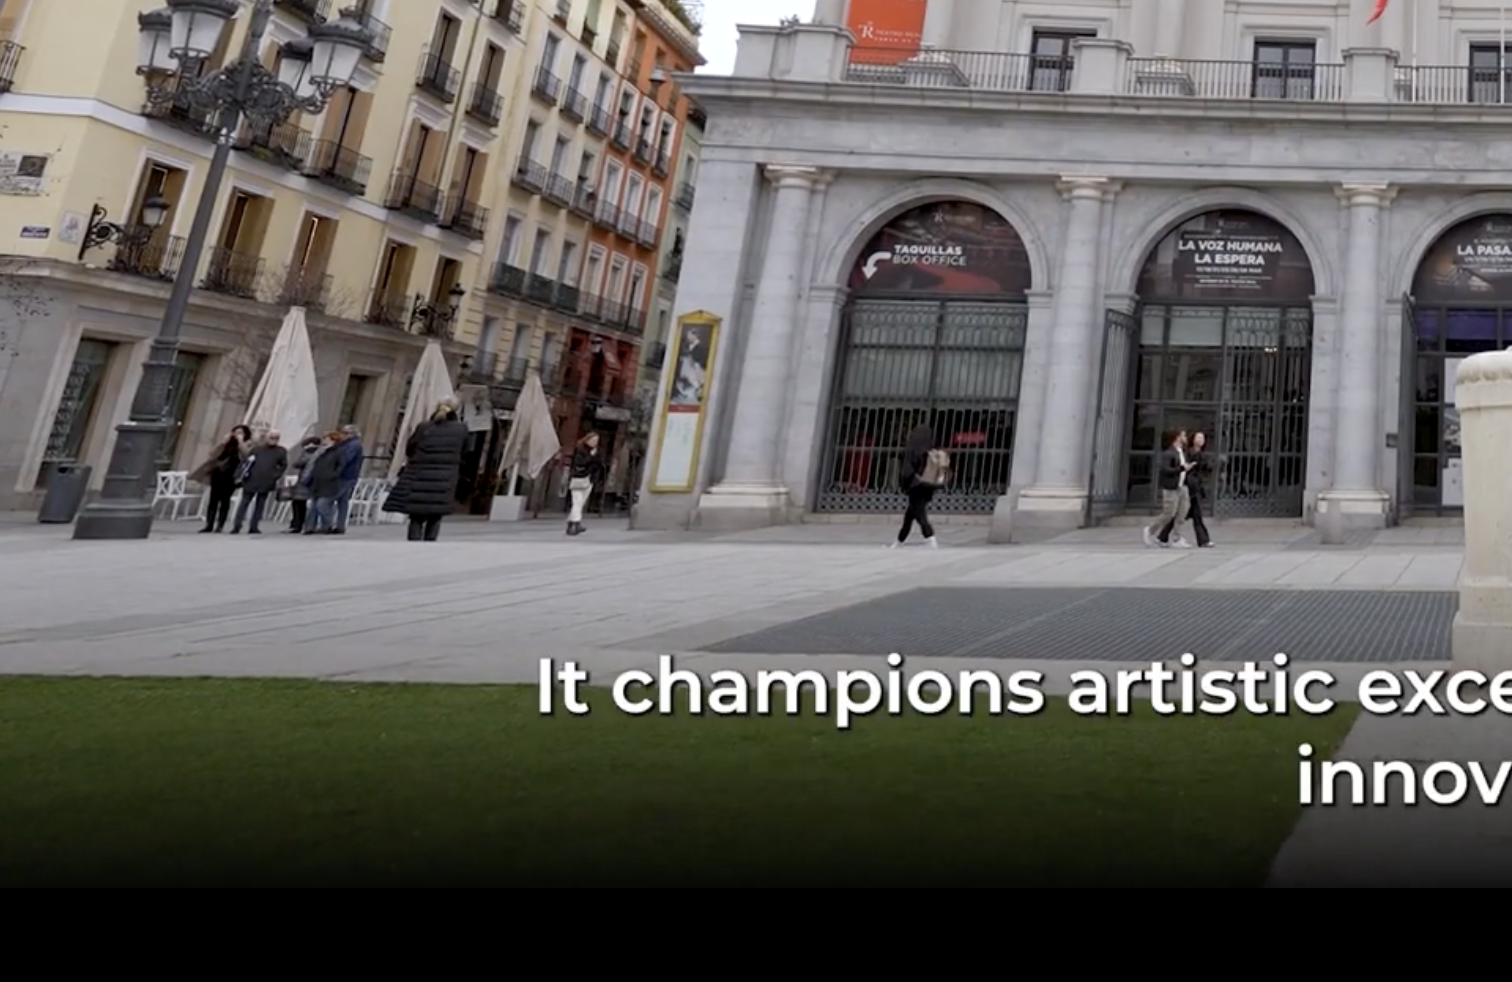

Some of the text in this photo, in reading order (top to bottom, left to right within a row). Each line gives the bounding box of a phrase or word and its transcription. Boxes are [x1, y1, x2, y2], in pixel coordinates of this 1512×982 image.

[894, 244, 962, 255] TAQUILLAS
[1178, 240, 1283, 252] LA VOZ HUMANA
[1457, 245, 1474, 256] LA
[893, 255, 967, 266] BOX OFFICE
[1194, 254, 1265, 265] LA ESPERA
